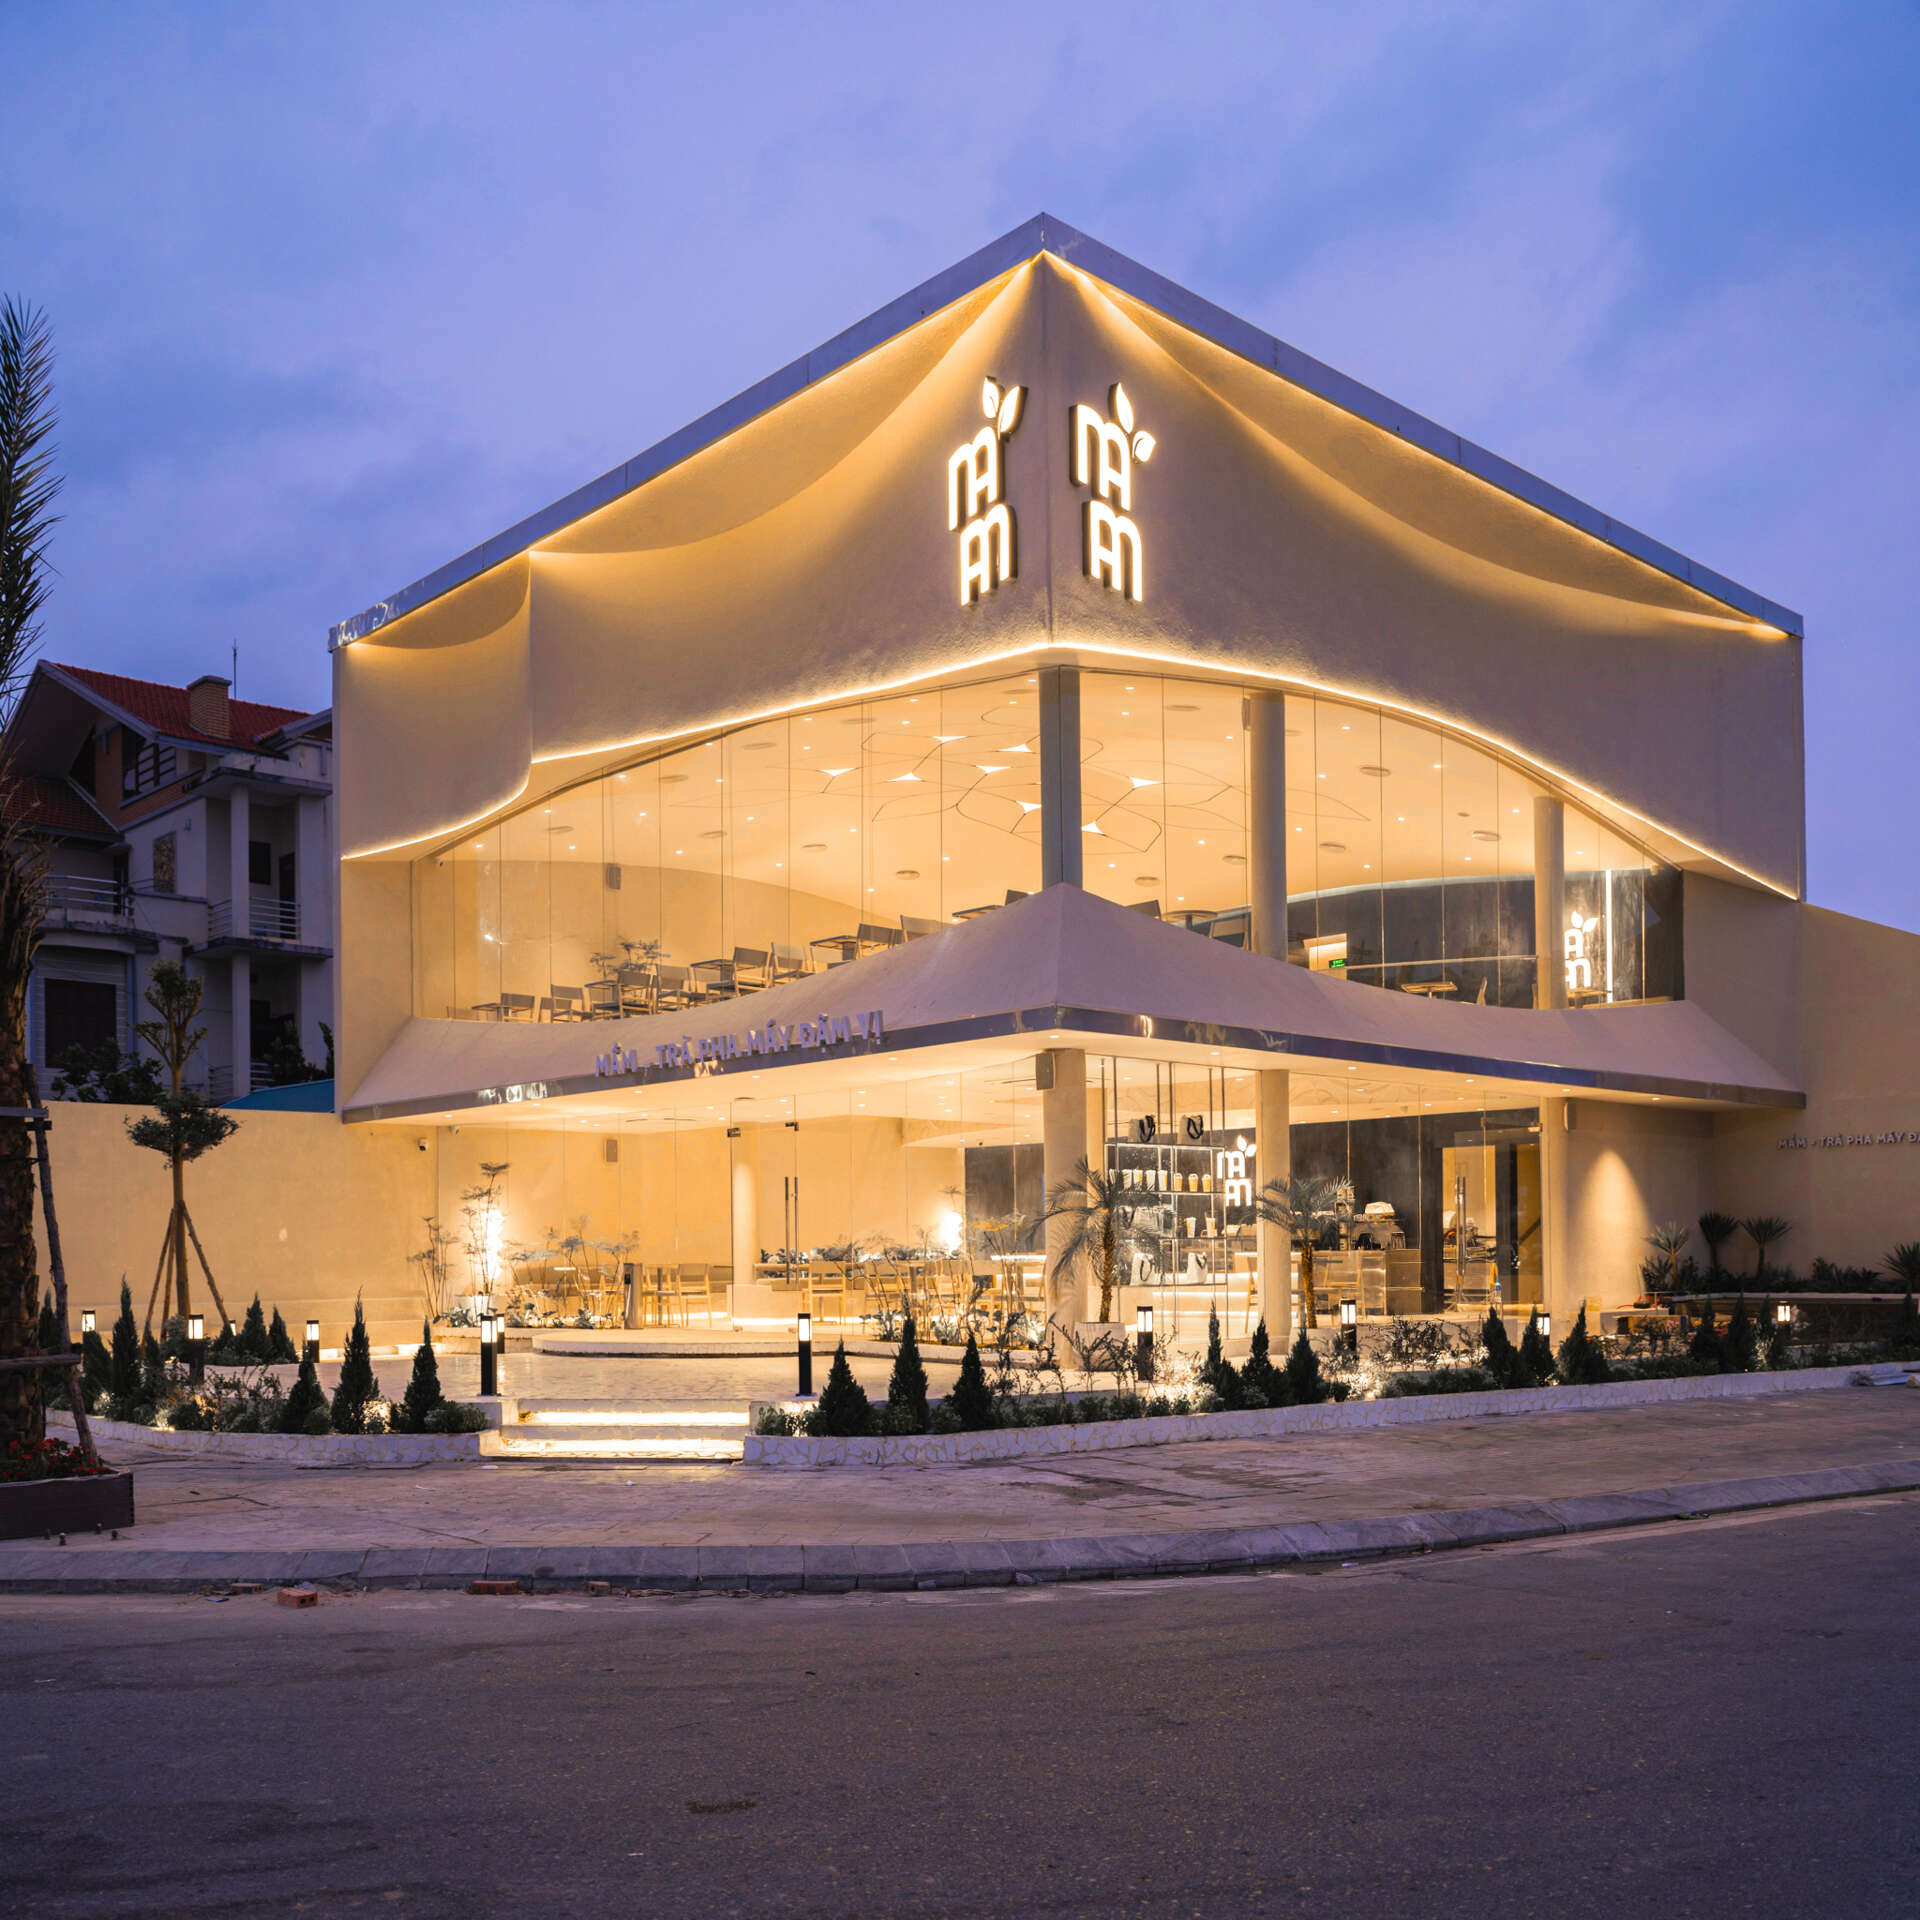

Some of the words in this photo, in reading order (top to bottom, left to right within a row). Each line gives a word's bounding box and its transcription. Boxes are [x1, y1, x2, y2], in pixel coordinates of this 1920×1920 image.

[655, 1035, 693, 1069] TRÀ
[698, 1034, 739, 1063] PHA
[856, 1009, 882, 1045] VỊ
[1846, 1134, 1873, 1145] PHA
